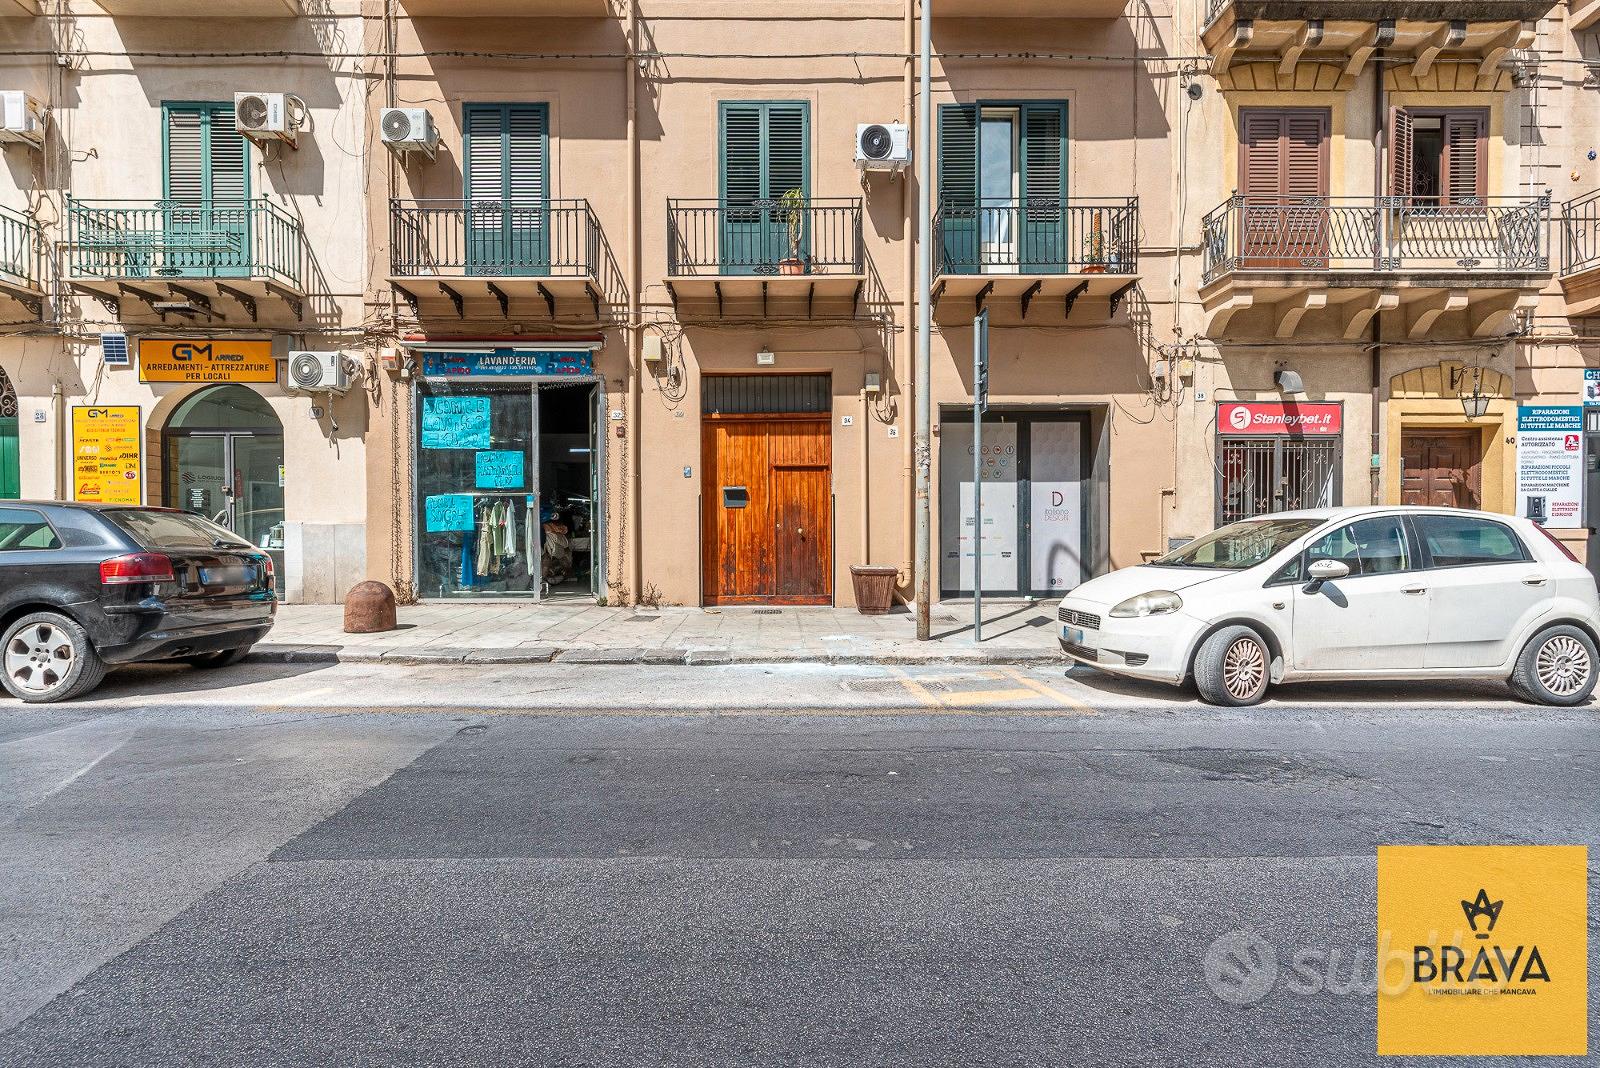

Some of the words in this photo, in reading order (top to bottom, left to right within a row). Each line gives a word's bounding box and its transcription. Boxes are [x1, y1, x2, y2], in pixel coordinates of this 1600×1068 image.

[171, 343, 213, 361] GM
[480, 356, 536, 366] LAVANDERIA
[146, 363, 203, 372] ARREDAMENTI
[211, 364, 270, 372] ATTREZZATURE
[186, 372, 200, 380] PER
[203, 372, 230, 380] LOCALI
[1253, 413, 1332, 426] Stanleybet.it
